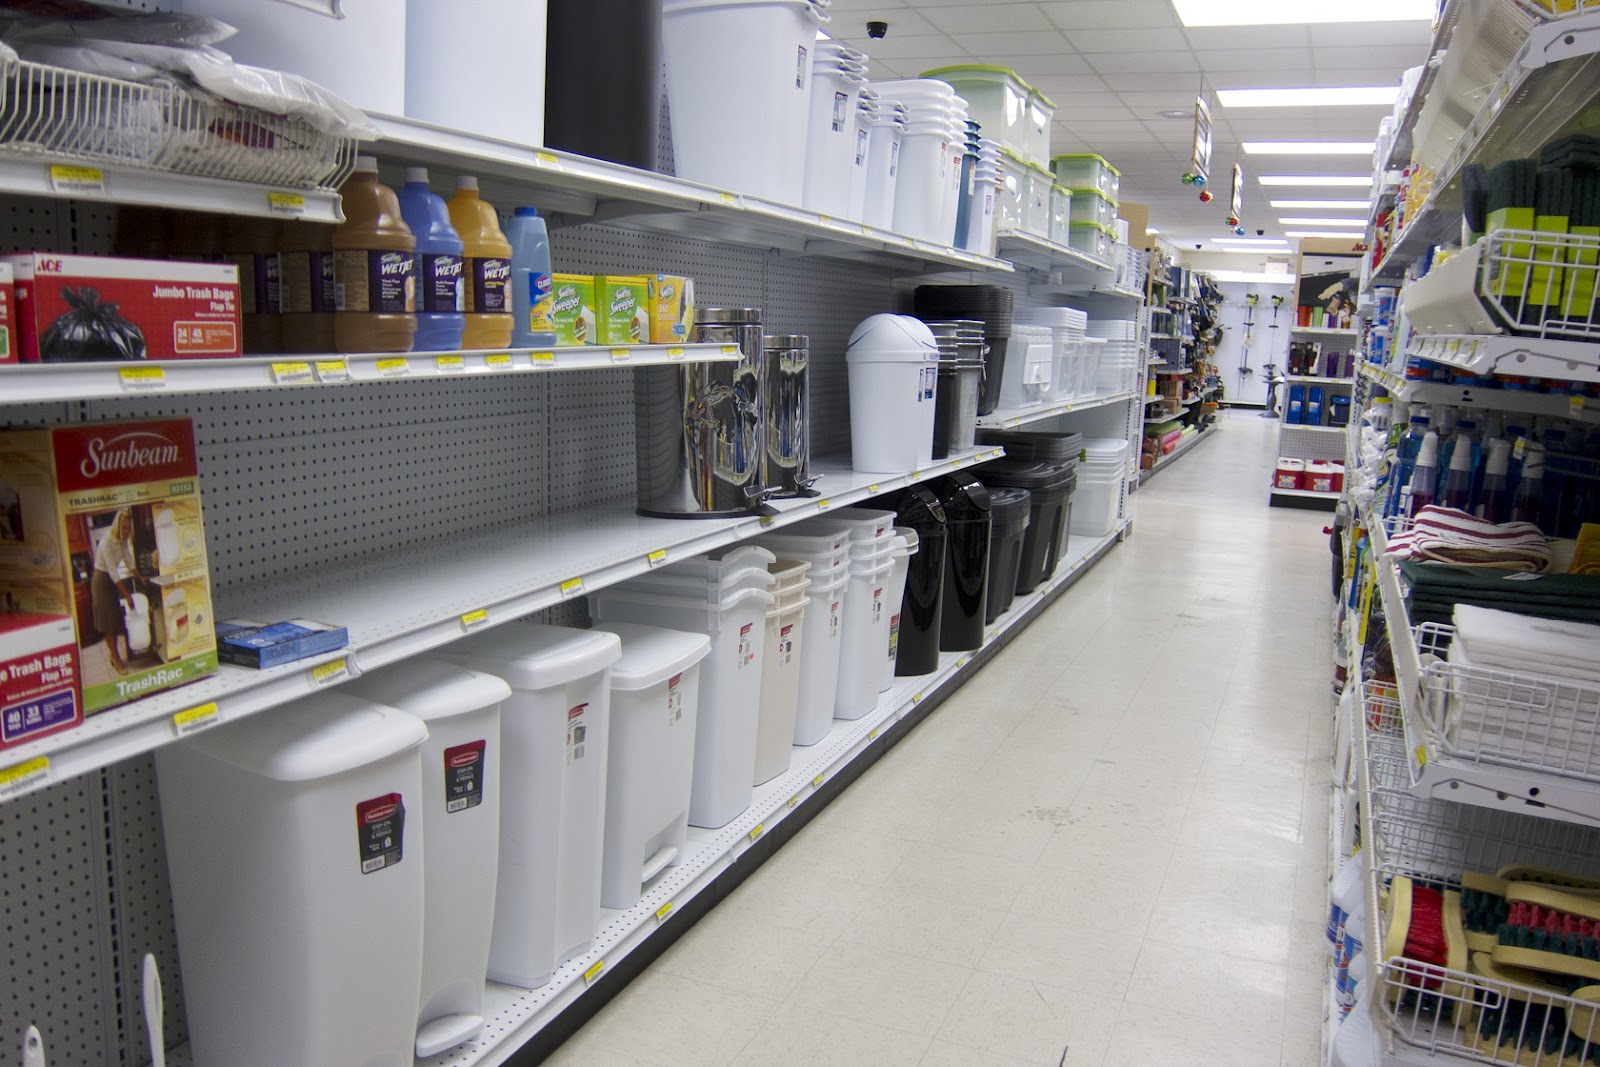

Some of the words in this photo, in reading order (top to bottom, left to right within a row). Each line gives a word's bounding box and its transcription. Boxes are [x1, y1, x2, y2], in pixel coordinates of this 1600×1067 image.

[37, 258, 63, 273] ACE
[152, 284, 185, 299] Jumbo
[185, 286, 212, 300] Trash
[212, 287, 236, 303] Bags
[209, 301, 225, 313] Flap
[553, 296, 581, 315] Sweeper
[610, 297, 636, 316] Sweeper
[80, 437, 179, 478] Sunbeam
[9, 659, 42, 679] Trash
[43, 652, 72, 669] Bags
[41, 671, 60, 683] Flap
[117, 668, 183, 697] TrashRac
[8, 711, 20, 724] 40
[27, 705, 39, 718] 33
